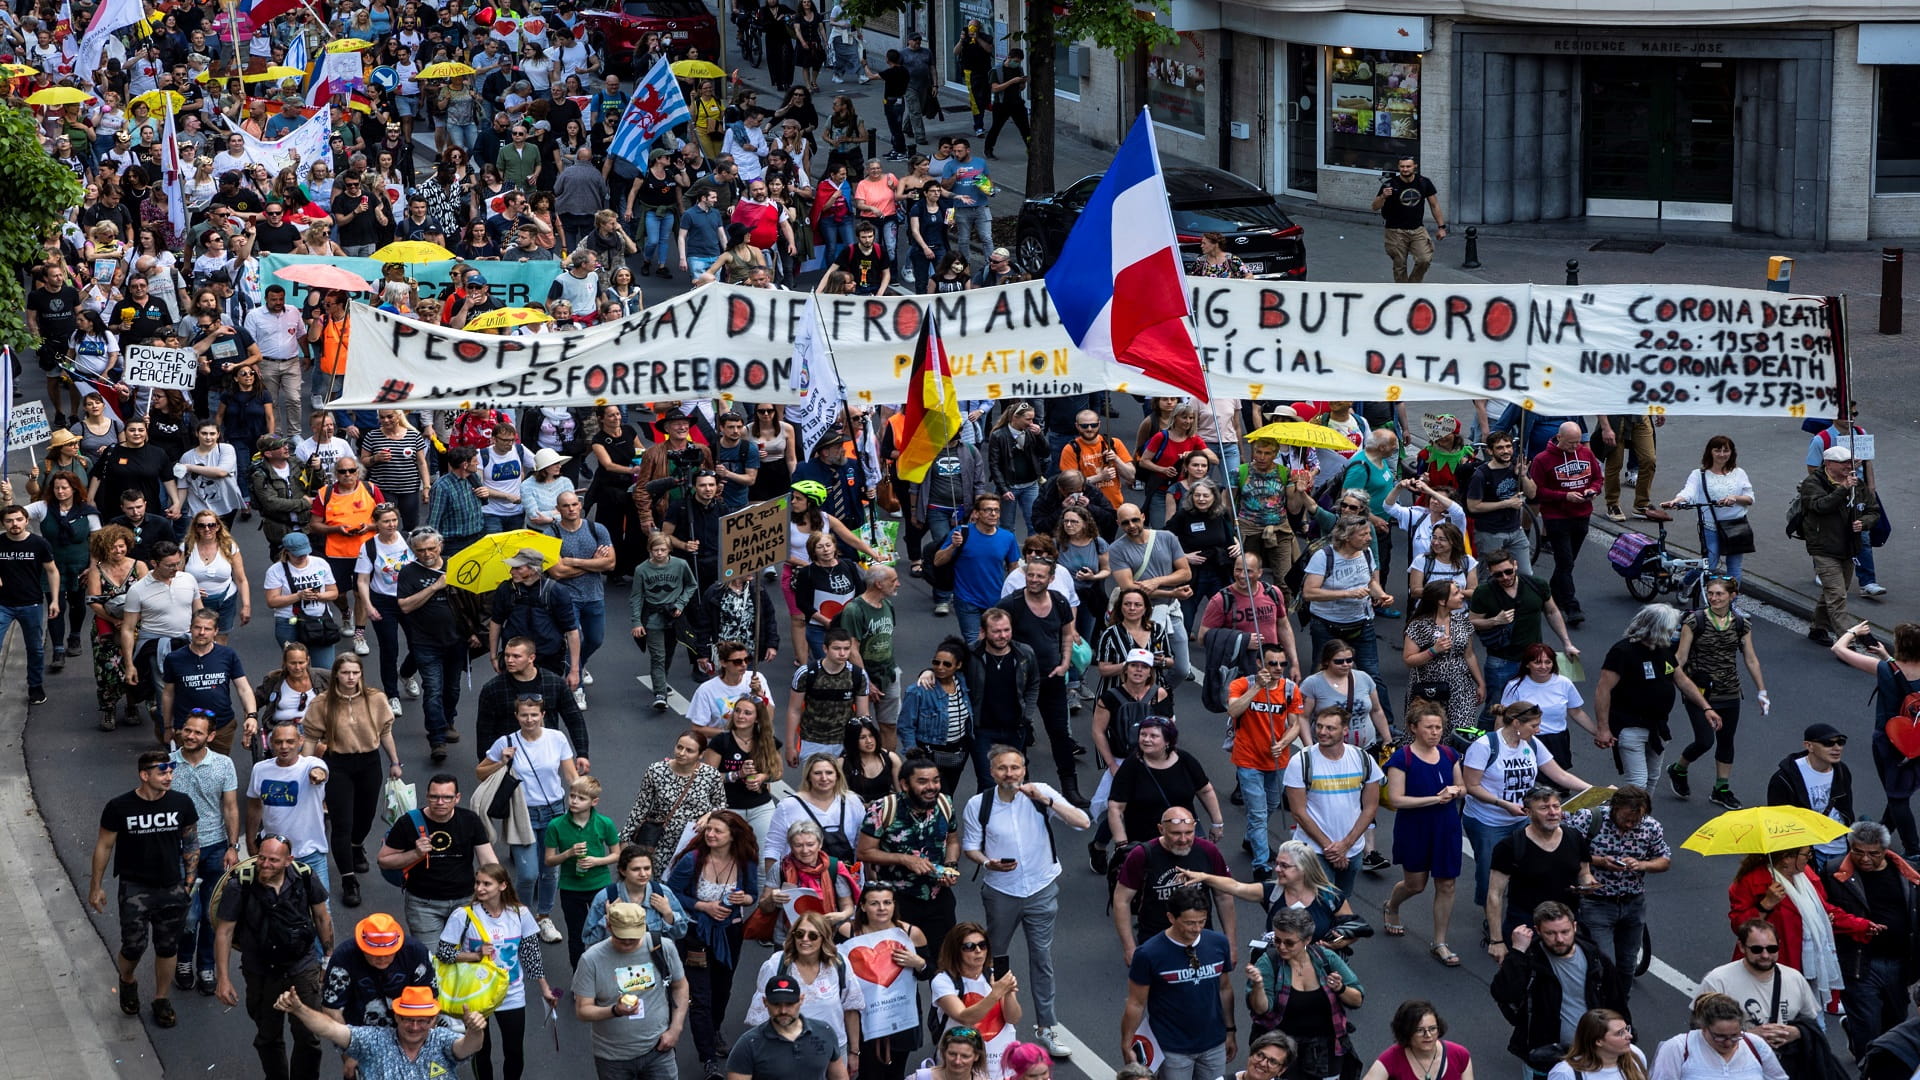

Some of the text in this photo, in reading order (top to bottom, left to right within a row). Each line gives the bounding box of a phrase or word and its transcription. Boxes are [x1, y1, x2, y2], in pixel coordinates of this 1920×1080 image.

[614, 294, 709, 346] MAY
[1259, 288, 1364, 337] BUT
[1628, 295, 1754, 325] CORONA
[130, 347, 186, 363] POWER
[138, 360, 181, 372] TO THE
[1366, 350, 1460, 385] DATA
[130, 366, 194, 388] PEACEFUL
[859, 390, 872, 402] 4
[1386, 385, 1402, 401] 8
[732, 522, 783, 551] PHARMA
[727, 534, 785, 565] BUSINESS
[740, 550, 776, 574] PLAN
[1250, 702, 1283, 714] NEXIT
[126, 811, 179, 830] FUCK
[1177, 964, 1216, 982] TOP GUN
